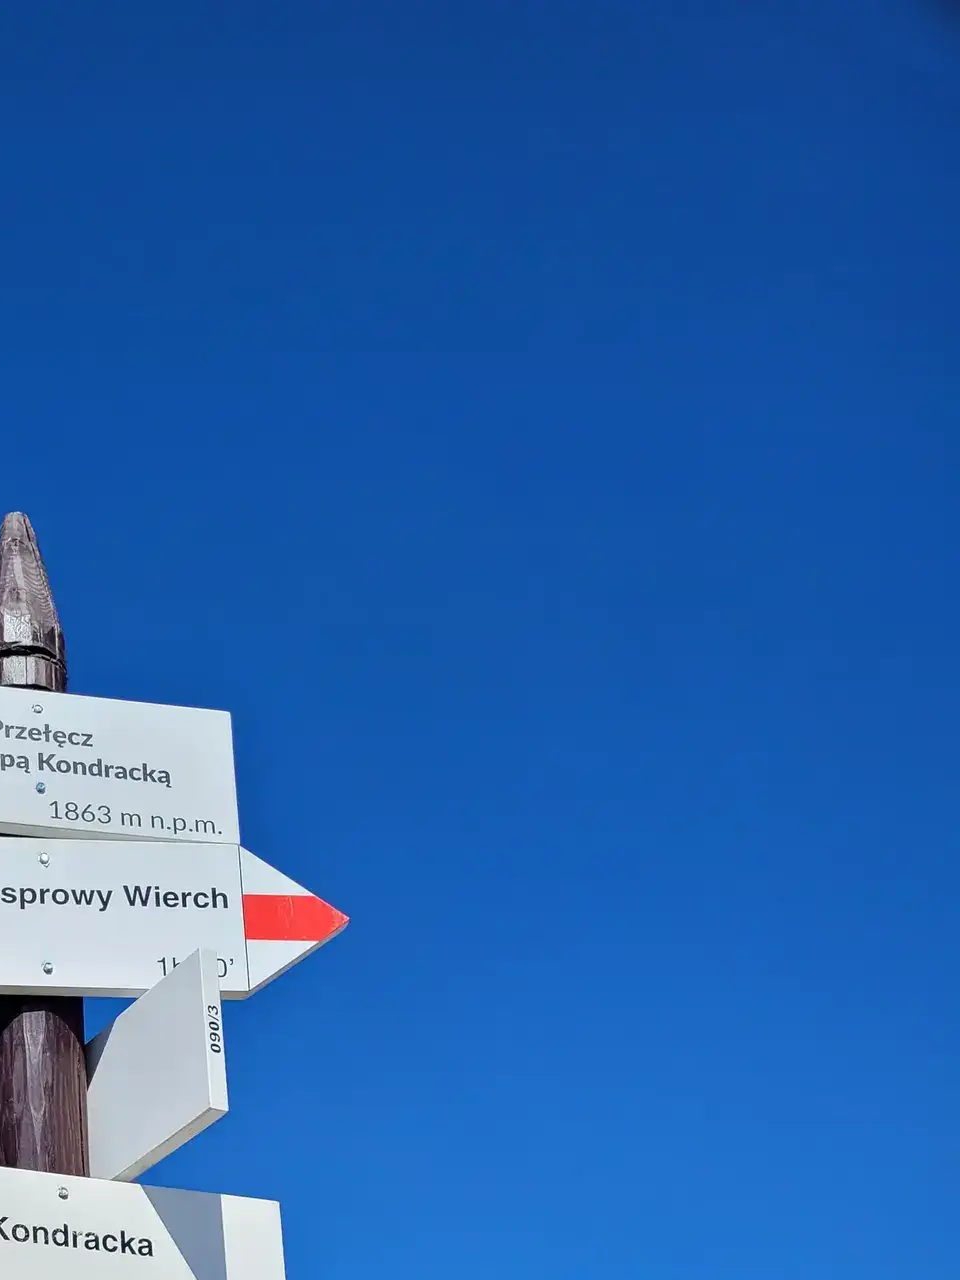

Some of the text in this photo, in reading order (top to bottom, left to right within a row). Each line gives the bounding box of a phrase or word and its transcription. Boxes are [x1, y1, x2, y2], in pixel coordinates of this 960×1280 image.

[37, 752, 173, 788] Kondracką
[49, 800, 223, 836] 1863 m n.p.m.
[122, 884, 229, 909] Wierch
[207, 1004, 222, 1054] 090/3
